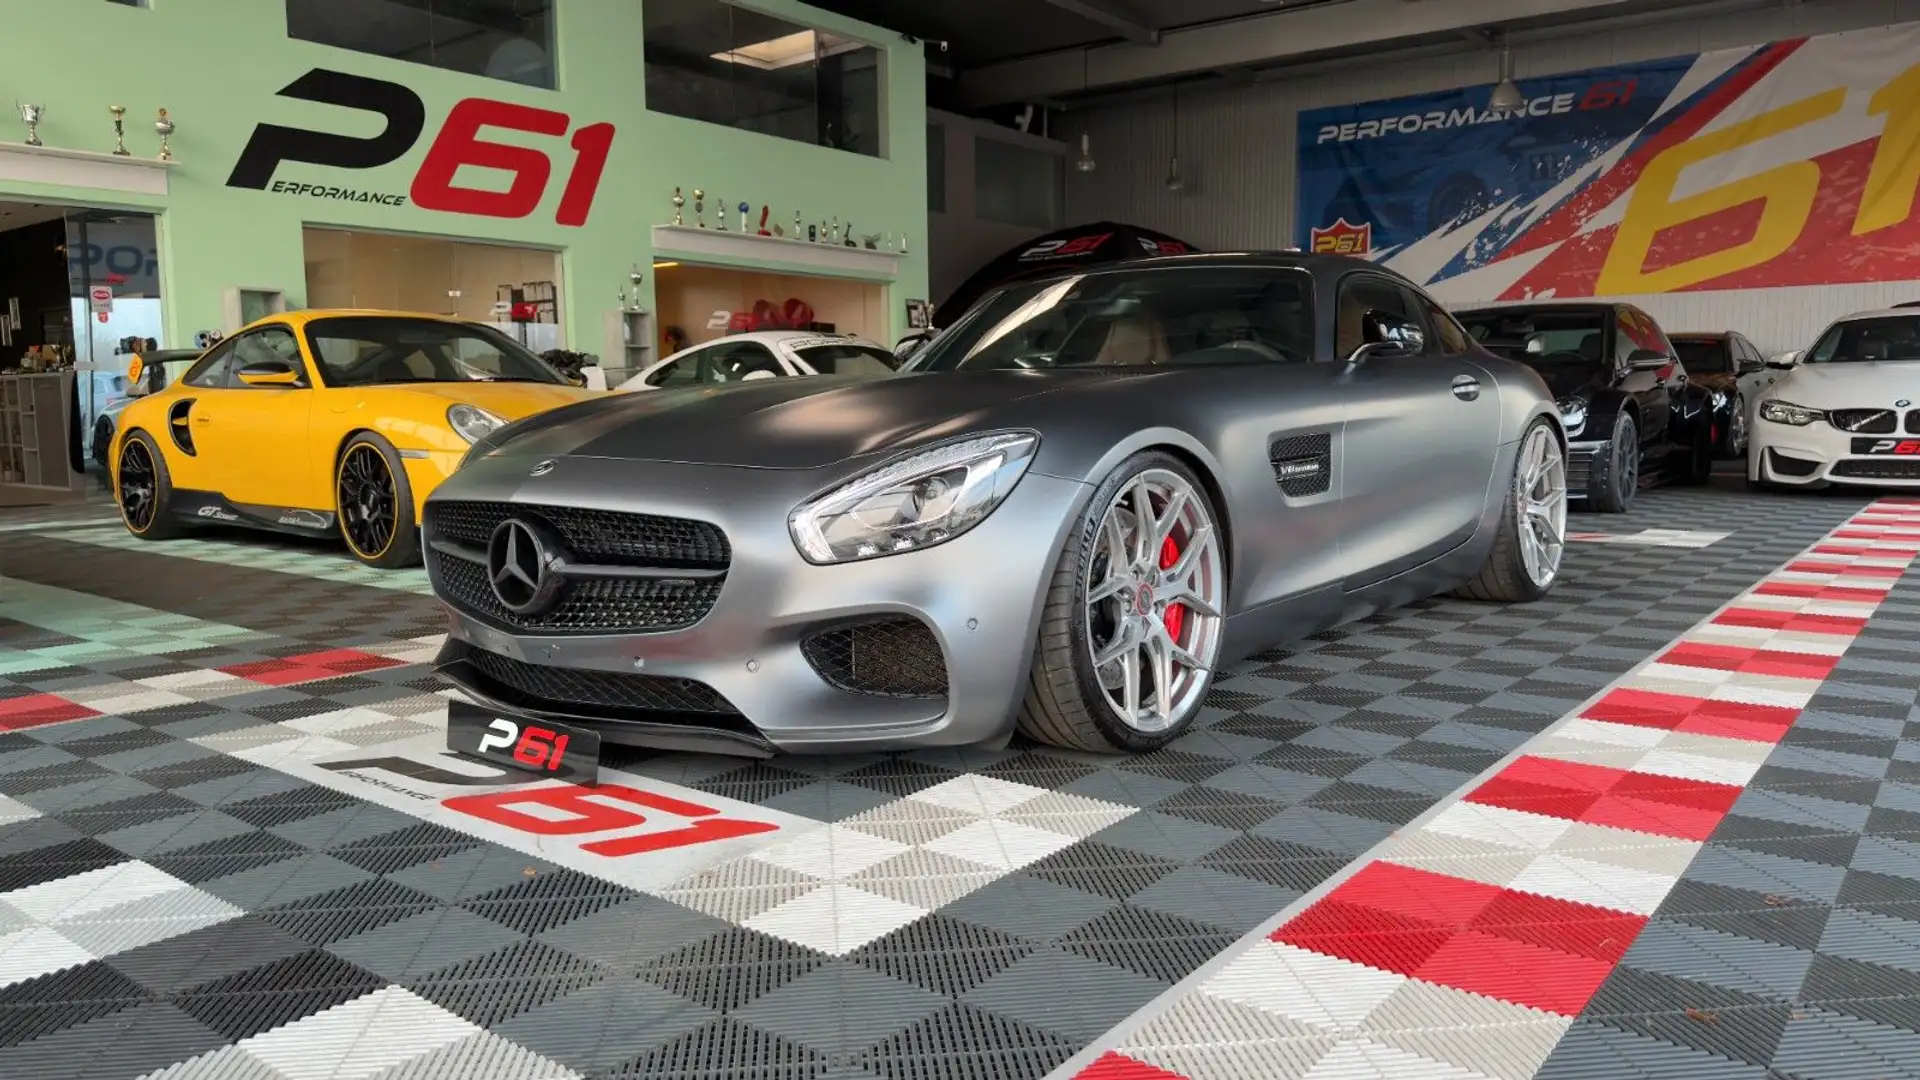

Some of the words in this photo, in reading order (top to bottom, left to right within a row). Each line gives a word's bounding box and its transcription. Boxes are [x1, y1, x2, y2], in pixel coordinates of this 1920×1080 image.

[1317, 92, 1575, 144] PERFORMANCE
[1579, 80, 1637, 111] 61
[226, 67, 616, 227] P61
[1316, 232, 1364, 253] P61
[1869, 440, 1920, 455] P6
[476, 718, 571, 771] P61
